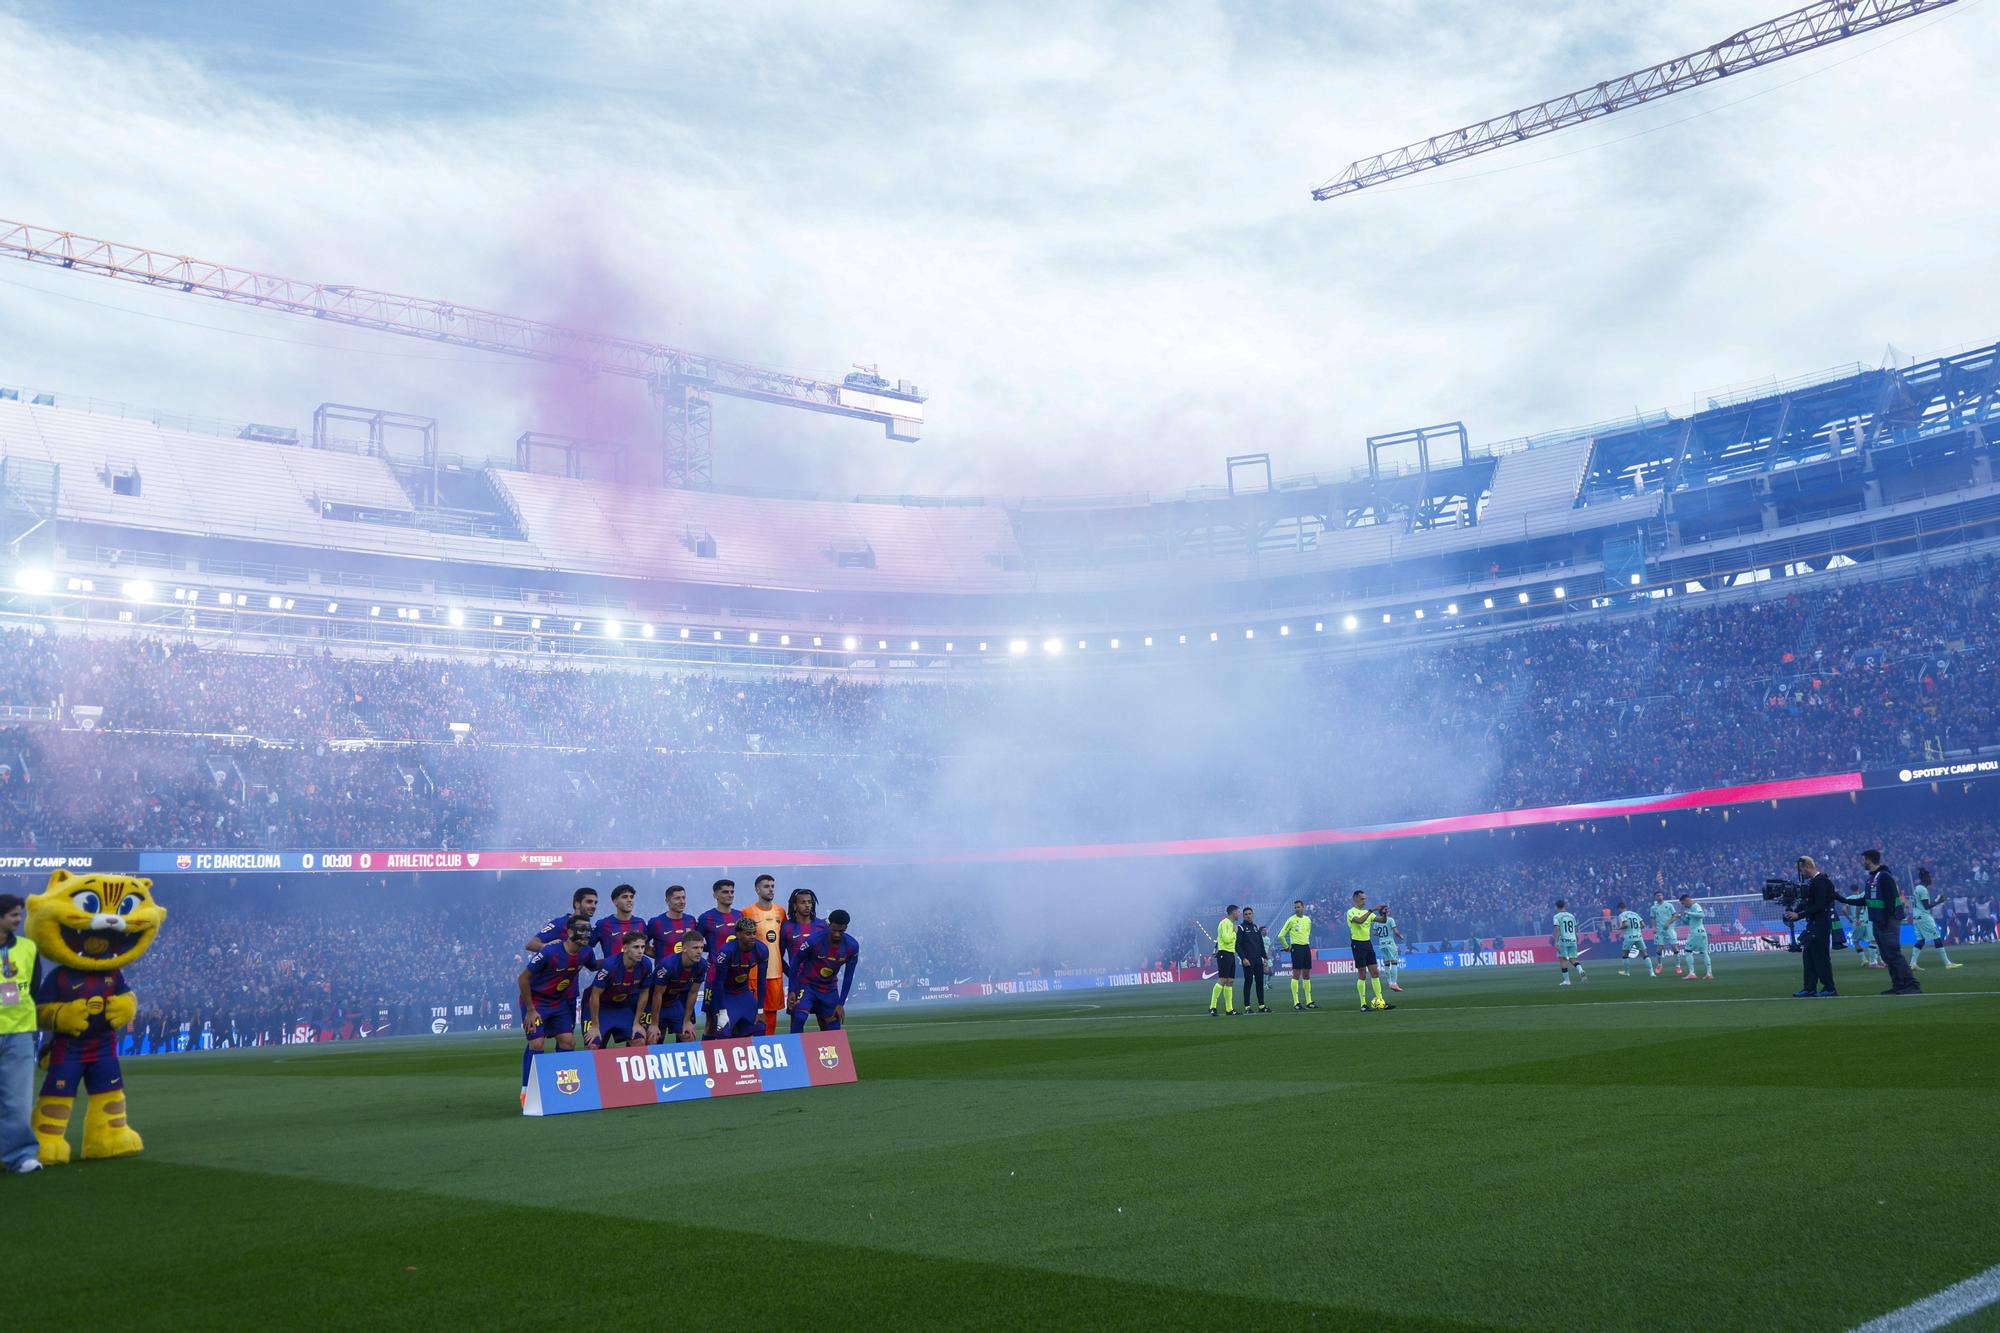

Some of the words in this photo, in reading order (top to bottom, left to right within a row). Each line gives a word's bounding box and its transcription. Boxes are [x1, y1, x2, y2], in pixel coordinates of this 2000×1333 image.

[1912, 767, 1949, 779] SPOTIFY
[1950, 763, 1977, 774] CAMP
[1978, 760, 1998, 771] NOU
[0, 858, 31, 868] OTIFY
[33, 857, 66, 868] CAMP
[68, 857, 92, 867] NOU
[196, 855, 211, 869] FC
[213, 854, 281, 868] BARCELONA
[302, 853, 314, 869] 0
[322, 854, 352, 868] 00:00
[360, 853, 372, 869] 0
[387, 854, 434, 868] ATHLETIC
[435, 853, 462, 868] CLUB
[1562, 920, 1574, 933] 18
[1628, 917, 1639, 929] 16
[1377, 925, 1389, 938] 20
[1499, 952, 1507, 965] A
[1507, 950, 1535, 965] CASA
[1026, 979, 1049, 993] CASA
[1108, 973, 1142, 987] TORNEM
[1143, 973, 1150, 985] A
[1150, 971, 1173, 985] CASA
[616, 1050, 709, 1083] TORNEM
[713, 1048, 728, 1074] A
[732, 1043, 788, 1072] CASA
